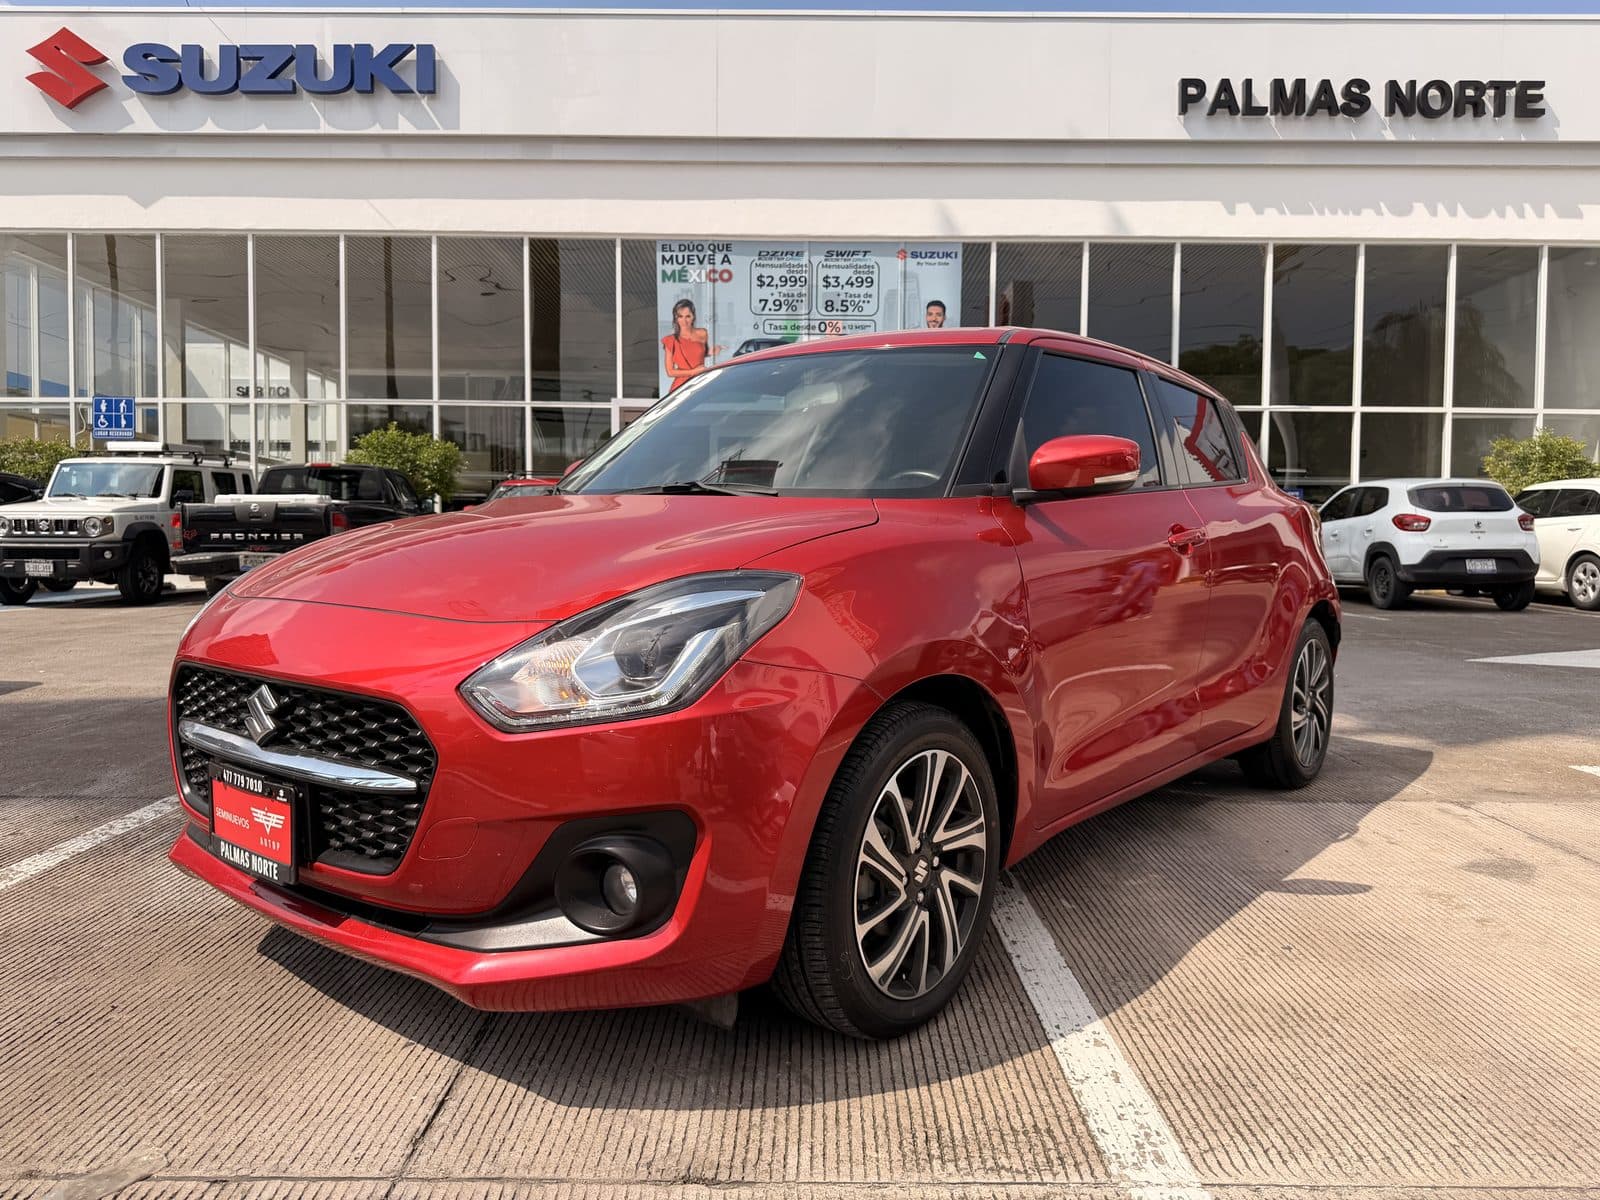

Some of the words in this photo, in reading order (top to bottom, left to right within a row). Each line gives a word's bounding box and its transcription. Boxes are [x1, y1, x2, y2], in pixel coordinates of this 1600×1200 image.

[122, 43, 437, 96] SUZUKI
[1178, 78, 1371, 118] PALMAS
[1385, 80, 1546, 119] NORTE
[661, 243, 675, 253] EL
[678, 241, 705, 253] DÚO
[708, 243, 733, 254] QUE
[823, 250, 871, 258] SWIFT
[910, 251, 958, 259] SUZUKI
[661, 254, 716, 266] MUEVE
[720, 254, 732, 265] A
[661, 266, 733, 284] MÉXICO
[756, 273, 808, 290] $2,999
[822, 274, 874, 290] $3,499
[864, 291, 873, 299] de
[768, 323, 788, 331] Tasa
[790, 323, 816, 331] desde
[818, 321, 841, 333] 0%
[215, 807, 250, 829] SEMINUEVOS
[220, 841, 250, 868] PALMAS
[251, 854, 279, 880] NORTE
